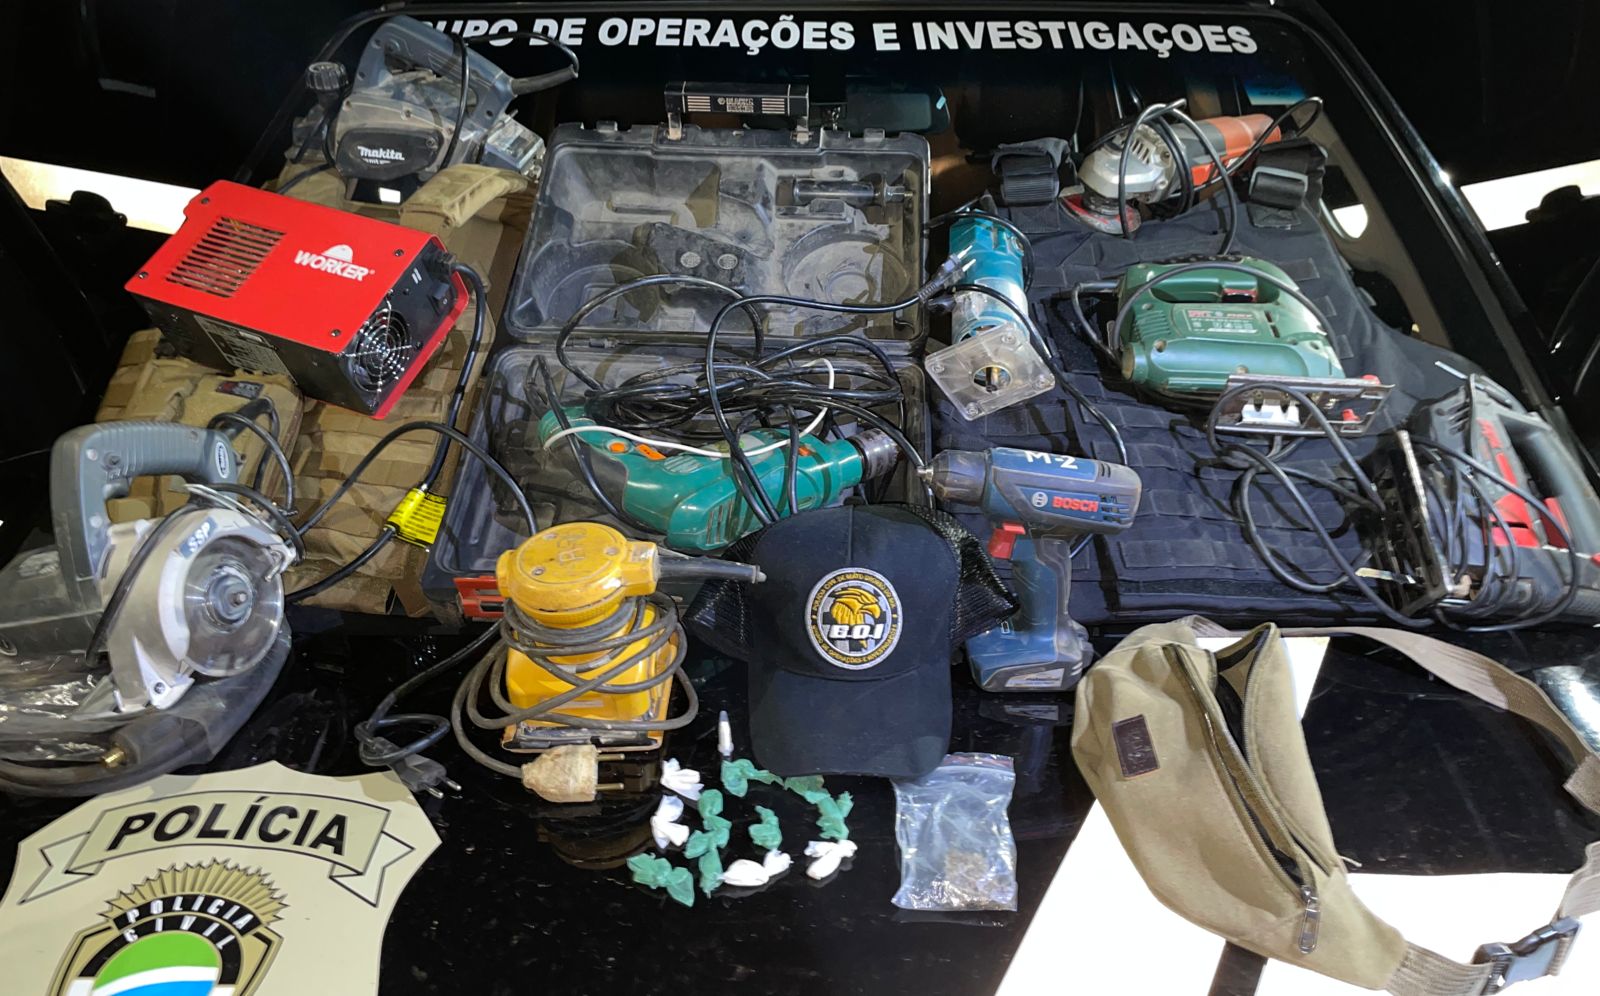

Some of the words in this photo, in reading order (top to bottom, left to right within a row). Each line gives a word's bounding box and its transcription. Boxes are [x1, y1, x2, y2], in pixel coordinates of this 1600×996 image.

[529, 18, 587, 46] DE
[598, 14, 855, 55] OPERAÇÕES
[872, 22, 901, 51] E
[912, 20, 1258, 58] INVESTIGAÇOES
[294, 249, 369, 282] WORKER
[1052, 495, 1099, 513] BOSCH
[187, 522, 210, 553] SSP
[106, 796, 348, 856] POLÍCIA
[123, 915, 236, 951] CIVIL
